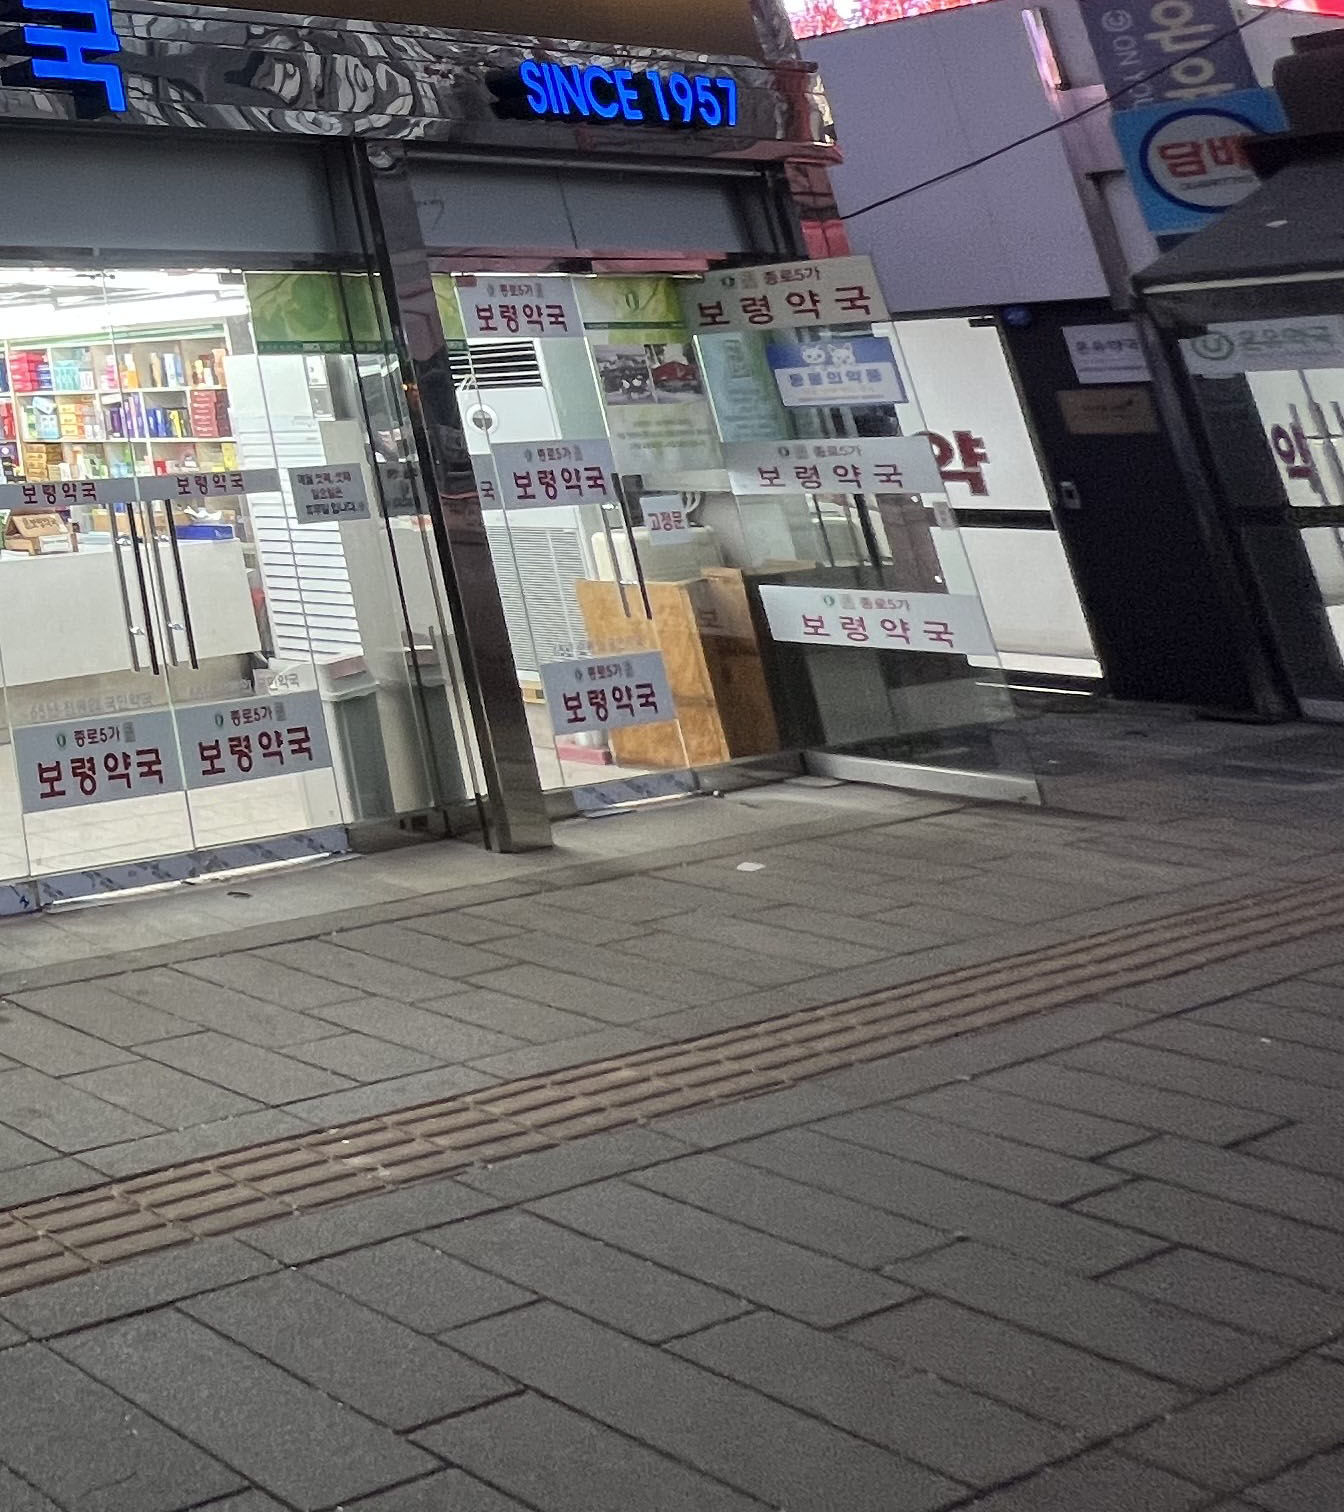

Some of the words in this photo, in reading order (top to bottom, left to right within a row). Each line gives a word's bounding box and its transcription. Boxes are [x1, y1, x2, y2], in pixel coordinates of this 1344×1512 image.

[519, 58, 644, 121] SINCE
[647, 68, 739, 127] 1957
[475, 304, 568, 333] 보령약국
[698, 285, 871, 326] 보령약국
[176, 472, 245, 496] 보령약국
[513, 466, 607, 501] 보령약국
[758, 464, 904, 489] 보령약국
[22, 481, 97, 504] 보령약국
[647, 511, 686, 532] 고정문
[802, 614, 955, 648] 보령약국
[230, 705, 273, 728] 종로5가
[562, 683, 659, 724] 보령약국
[73, 725, 120, 748] 종로5가
[198, 726, 313, 776] 보령약국
[37, 748, 164, 800] 보령약국
